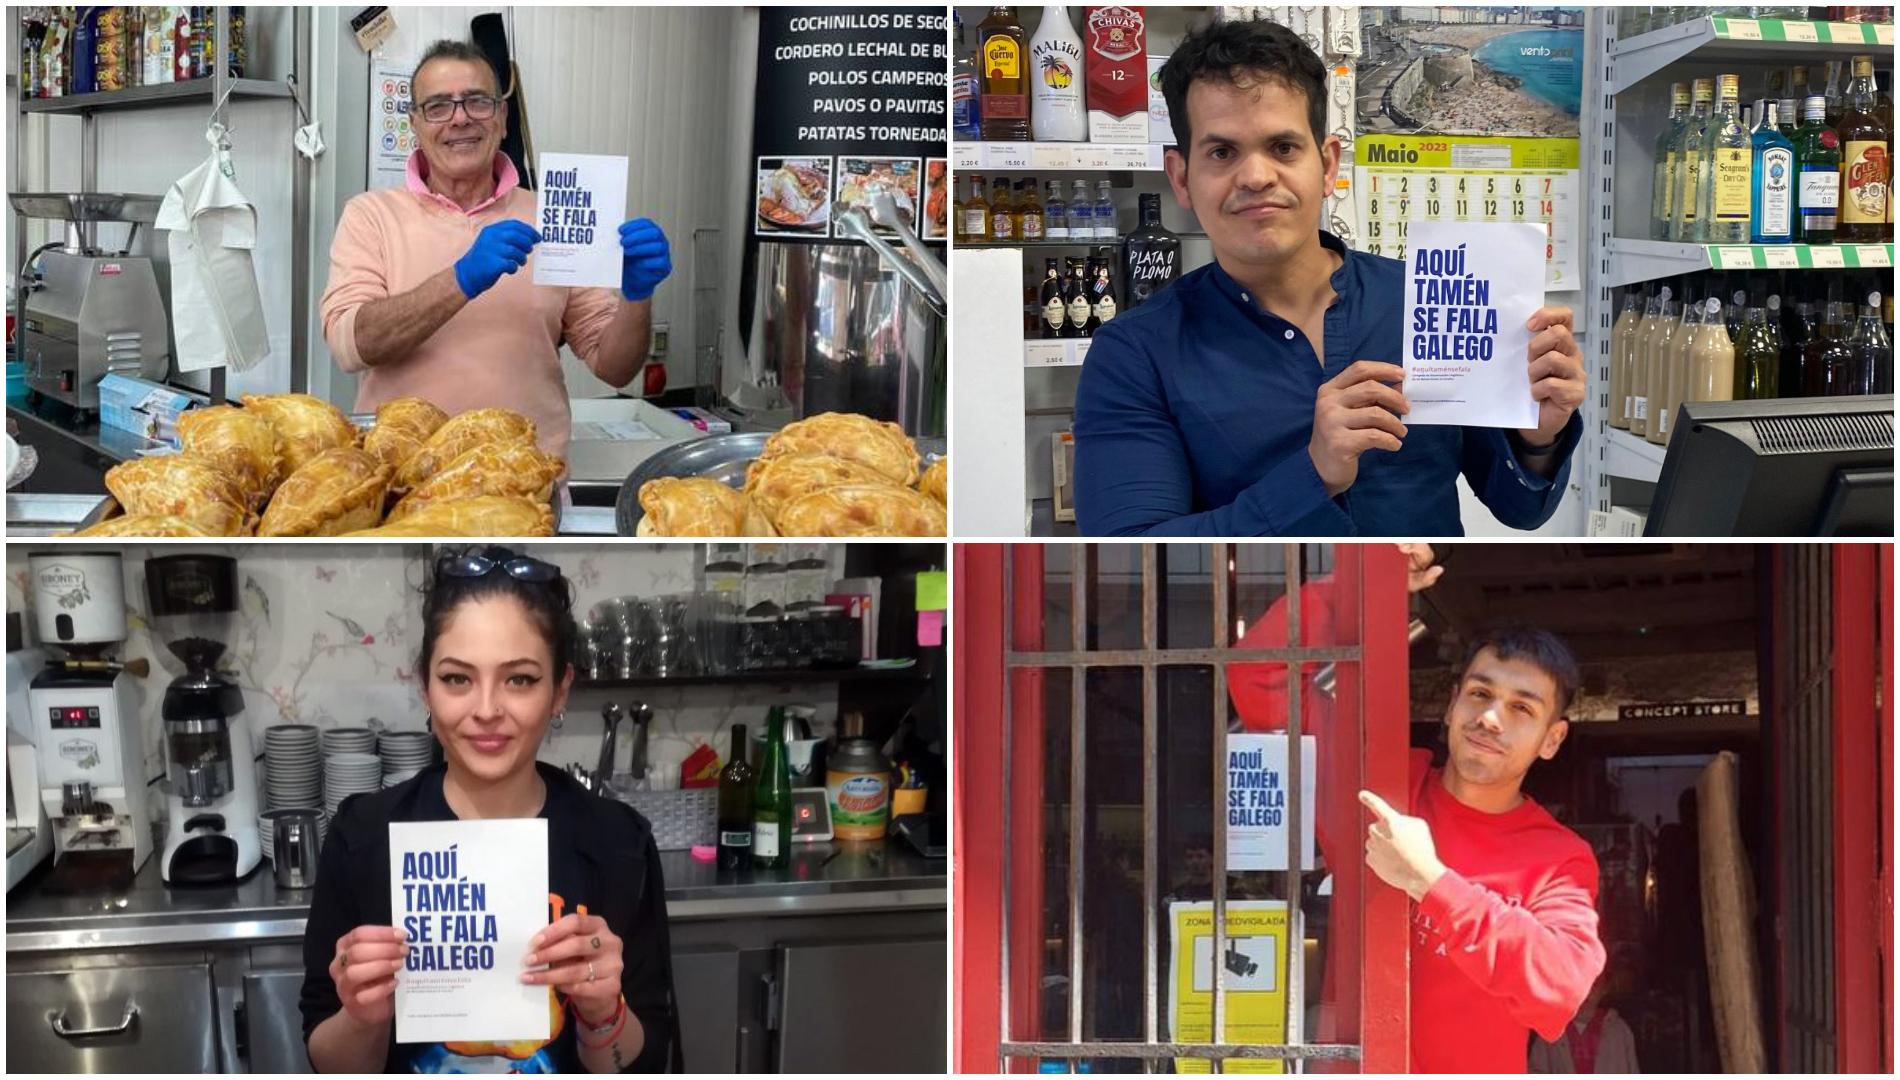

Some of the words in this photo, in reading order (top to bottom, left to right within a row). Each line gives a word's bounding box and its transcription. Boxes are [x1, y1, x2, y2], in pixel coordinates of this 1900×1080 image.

[790, 14, 889, 32] COCHINILLOS
[893, 14, 913, 28] DE
[1098, 17, 1135, 28] CHIVAS
[775, 43, 843, 60] CORDERO
[848, 42, 906, 57] LECHAL
[911, 43, 929, 58] DE
[808, 70, 867, 85] POLLOS
[1112, 70, 1125, 80] 12
[813, 98, 866, 113] PAVOS
[870, 98, 882, 113] O
[885, 98, 945, 114] PAVITAS
[798, 126, 866, 141] PATATAS
[869, 126, 947, 142] TORNEADA
[1368, 143, 1418, 163] Maio
[1419, 143, 1447, 152] 2023
[545, 168, 577, 189] AQUÍ
[1372, 176, 1377, 192] 1
[1401, 177, 1407, 193] 2
[1430, 177, 1437, 193] 3
[1459, 177, 1465, 193] 4
[1487, 178, 1494, 194] 5
[1515, 178, 1521, 194] 6
[1544, 178, 1552, 194] 7
[544, 187, 592, 208] TAMÉN
[1371, 199, 1378, 215] 8
[1400, 199, 1407, 215] 9
[1427, 199, 1440, 215] 10
[1457, 199, 1467, 215] 11
[1485, 200, 1497, 216] 12
[1512, 200, 1524, 216] 13
[1540, 200, 1553, 216] 14
[543, 208, 559, 225] SE
[564, 210, 597, 227] FALA
[542, 226, 593, 244] GALEGO
[1368, 221, 1381, 237] 15
[1129, 250, 1164, 266] PLATA
[1167, 250, 1175, 265] O
[1415, 243, 1466, 277] AQUÍ
[1133, 265, 1172, 280] PLOMO
[1414, 273, 1489, 306] TAMÉN
[1413, 307, 1439, 332] SE
[1446, 308, 1498, 334] FALA
[1412, 335, 1493, 361] GALEGO
[1624, 706, 1688, 718] CONCEPT
[1694, 704, 1740, 715] STORE
[1229, 748, 1262, 770] AQUÍ
[1229, 768, 1279, 788] TAMÉN
[1229, 790, 1245, 807] SE
[1250, 790, 1284, 807] FALA
[1229, 809, 1282, 826] GALEGO
[402, 844, 458, 881] AQUÍ
[402, 876, 486, 912] TAMÉN
[404, 915, 432, 943] SE
[441, 915, 498, 942] FALA
[1186, 918, 1211, 926] ZONA
[405, 945, 494, 972] GALEGO
